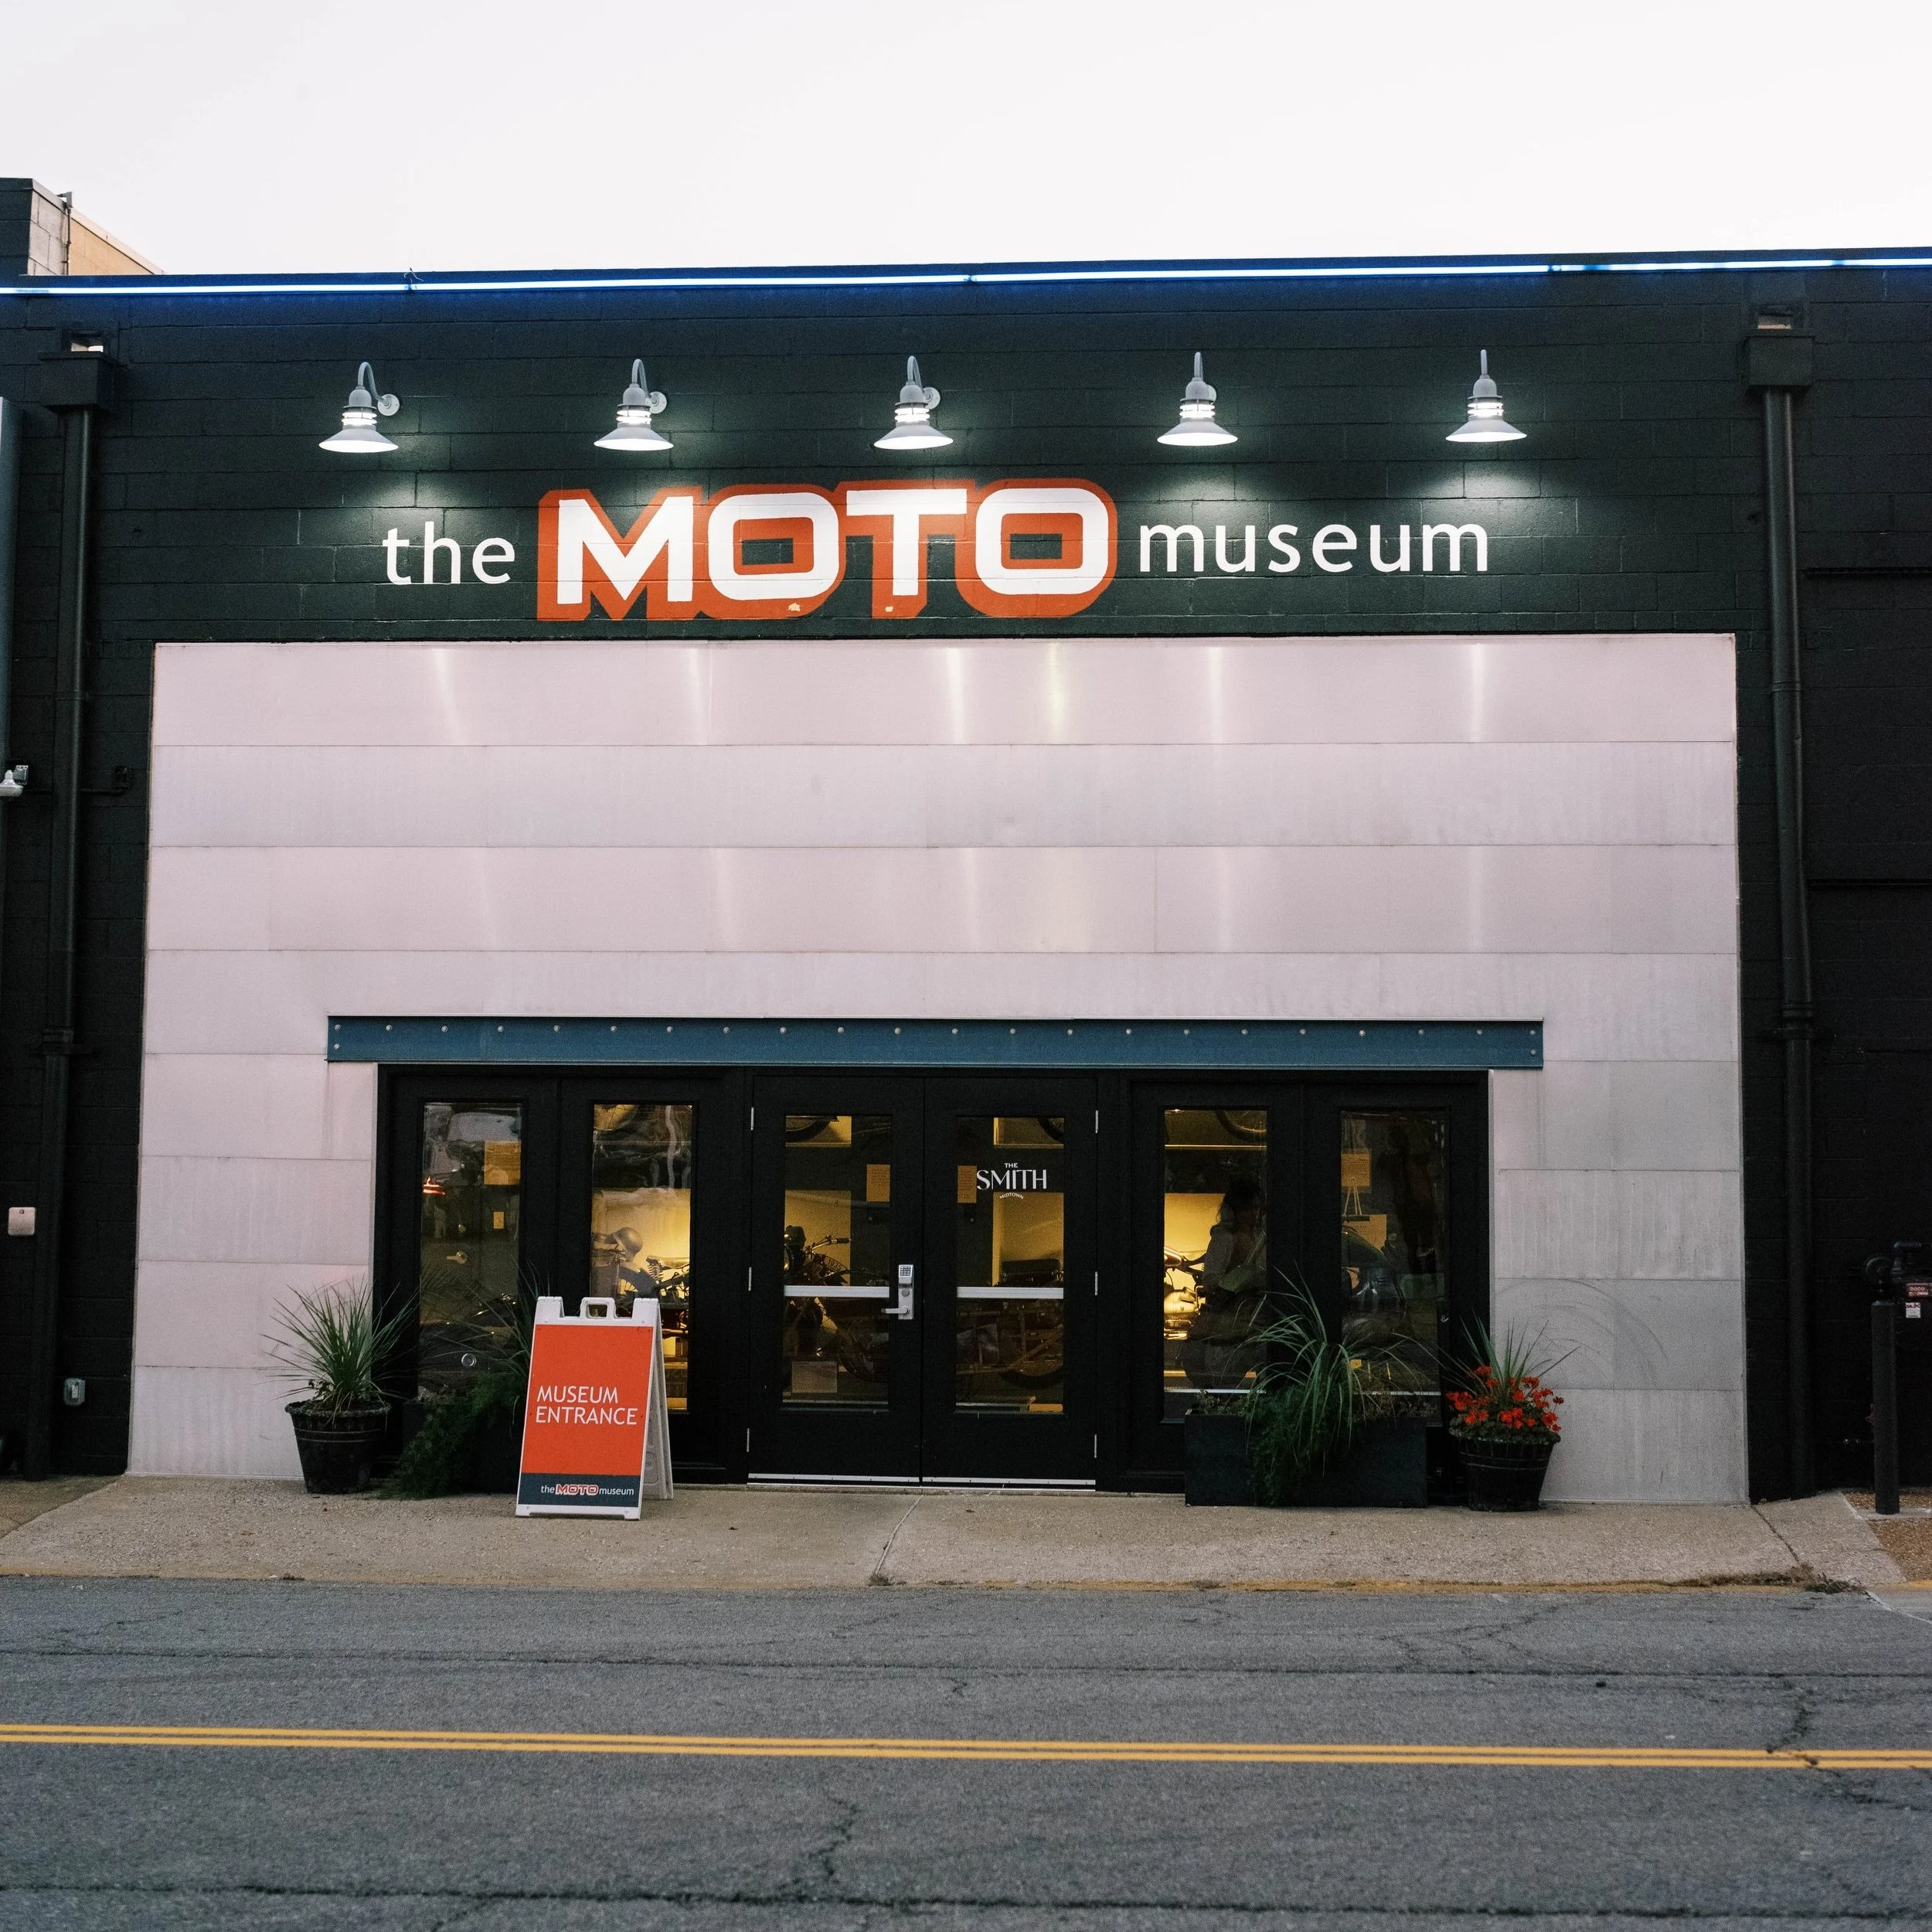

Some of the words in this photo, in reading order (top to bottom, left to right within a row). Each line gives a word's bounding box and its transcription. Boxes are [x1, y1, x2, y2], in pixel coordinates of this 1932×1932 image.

[383, 522, 515, 585] the
[553, 485, 1111, 607] MOTO
[1139, 522, 1488, 573] museum
[976, 1169, 1047, 1189] SMITH
[536, 1385, 618, 1404] MUSEUM
[536, 1406, 638, 1425] ENTRANCE
[541, 1485, 555, 1493] the
[556, 1484, 599, 1495] MOTO
